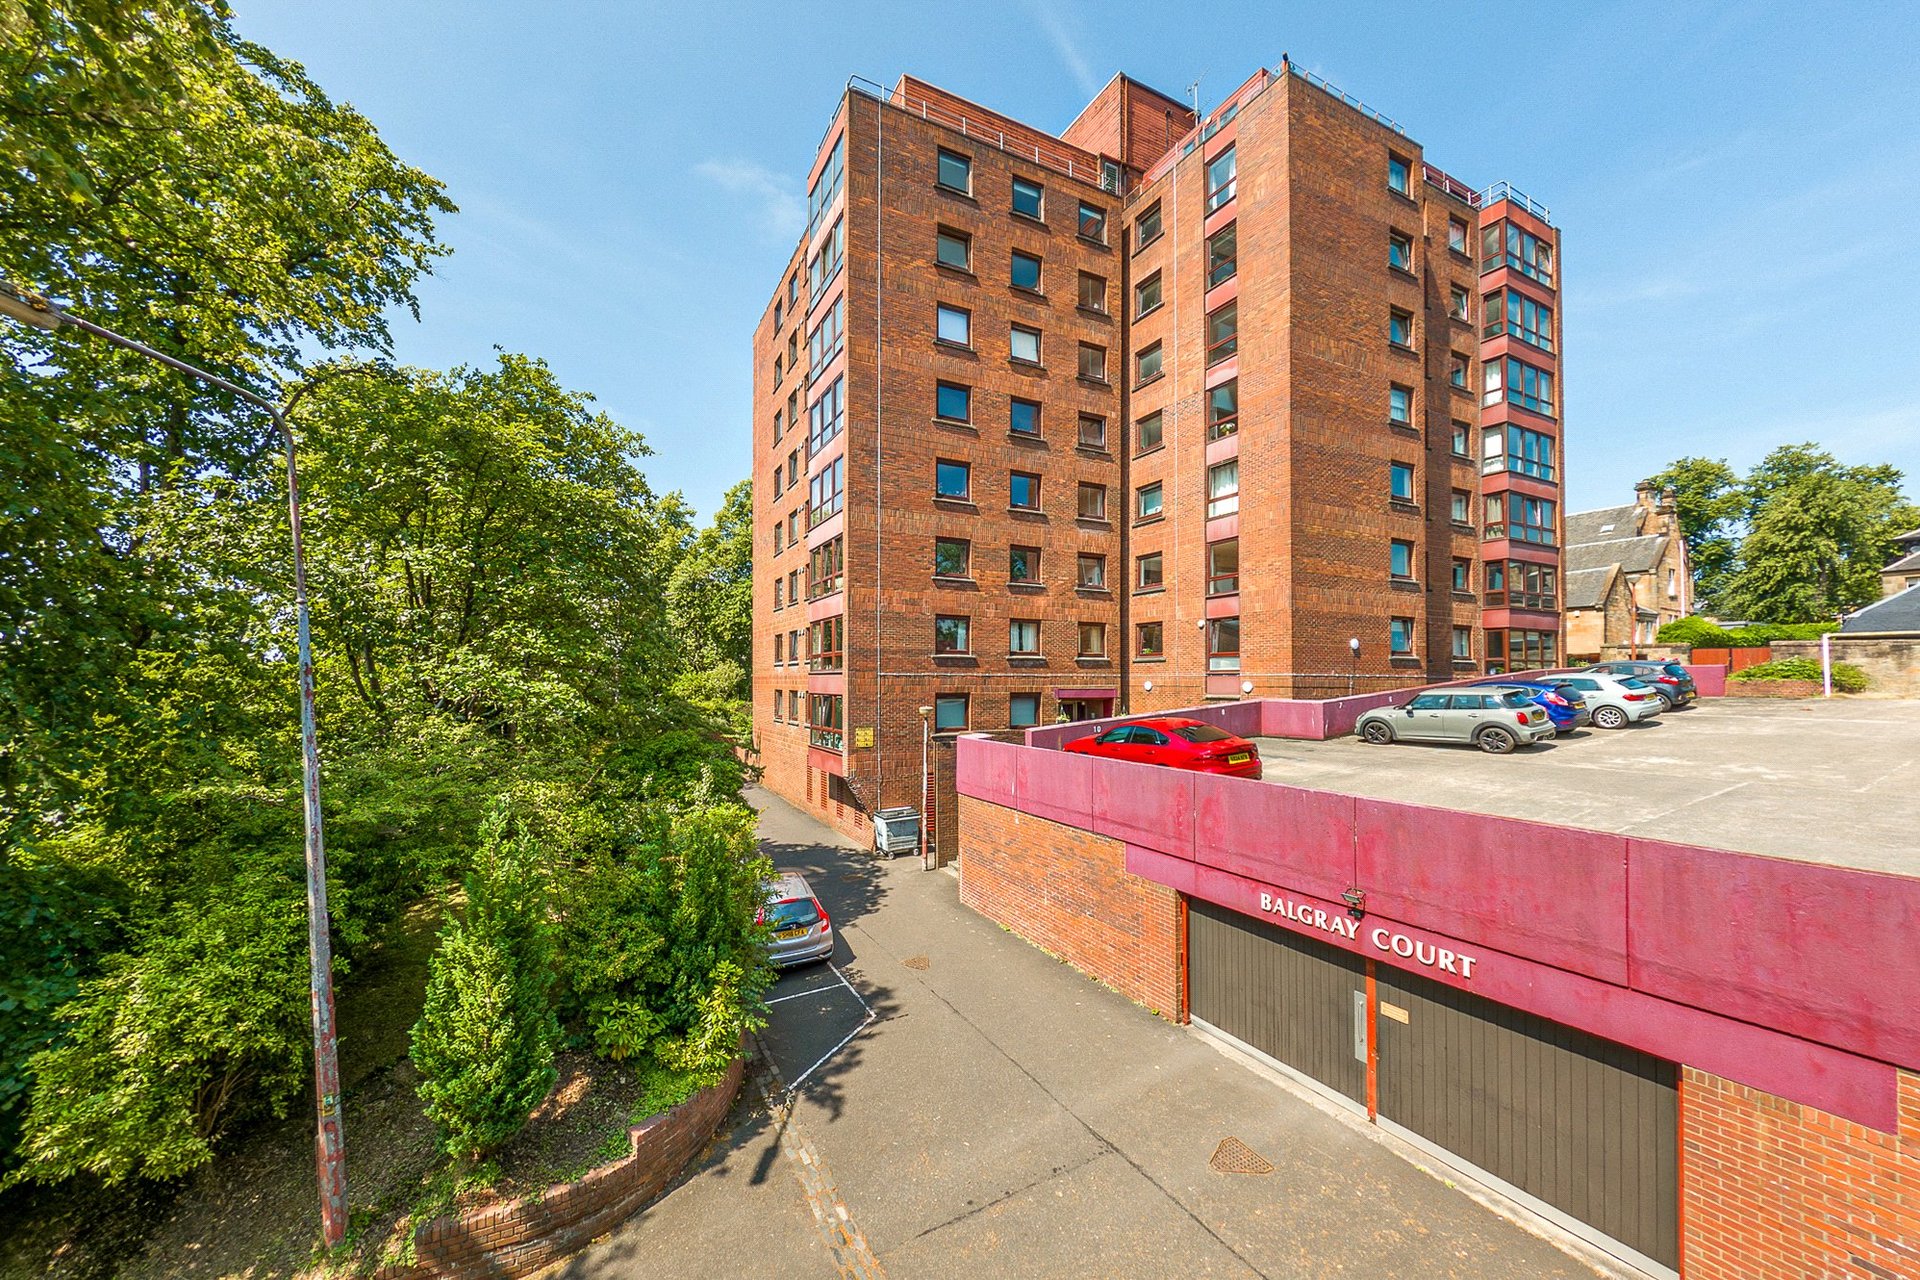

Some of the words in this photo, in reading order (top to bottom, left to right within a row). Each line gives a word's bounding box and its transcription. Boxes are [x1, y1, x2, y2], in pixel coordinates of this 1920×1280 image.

[1093, 725, 1102, 733] 10
[1260, 892, 1360, 940] BALGRAY
[1371, 928, 1476, 978] COURT
